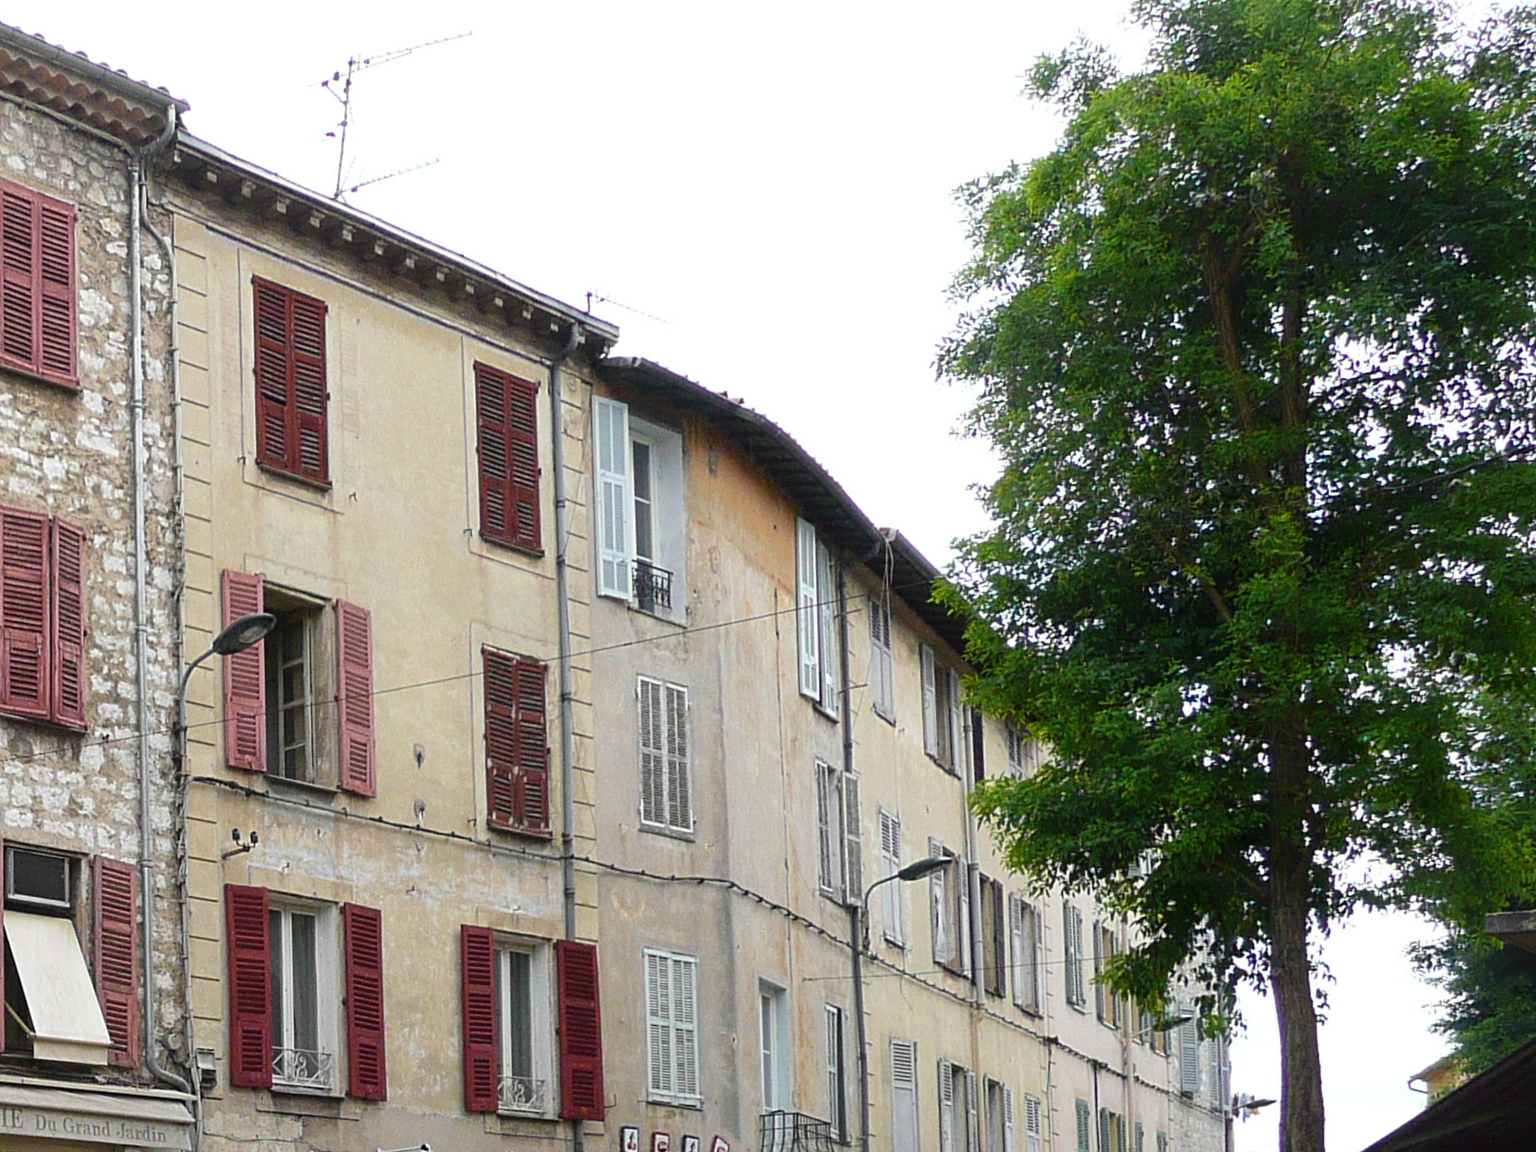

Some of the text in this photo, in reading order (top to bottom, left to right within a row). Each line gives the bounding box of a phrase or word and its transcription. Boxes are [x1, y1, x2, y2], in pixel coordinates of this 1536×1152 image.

[35, 1114, 57, 1132] Du
[63, 1116, 112, 1138] Grand
[116, 1121, 168, 1143] Jardin
